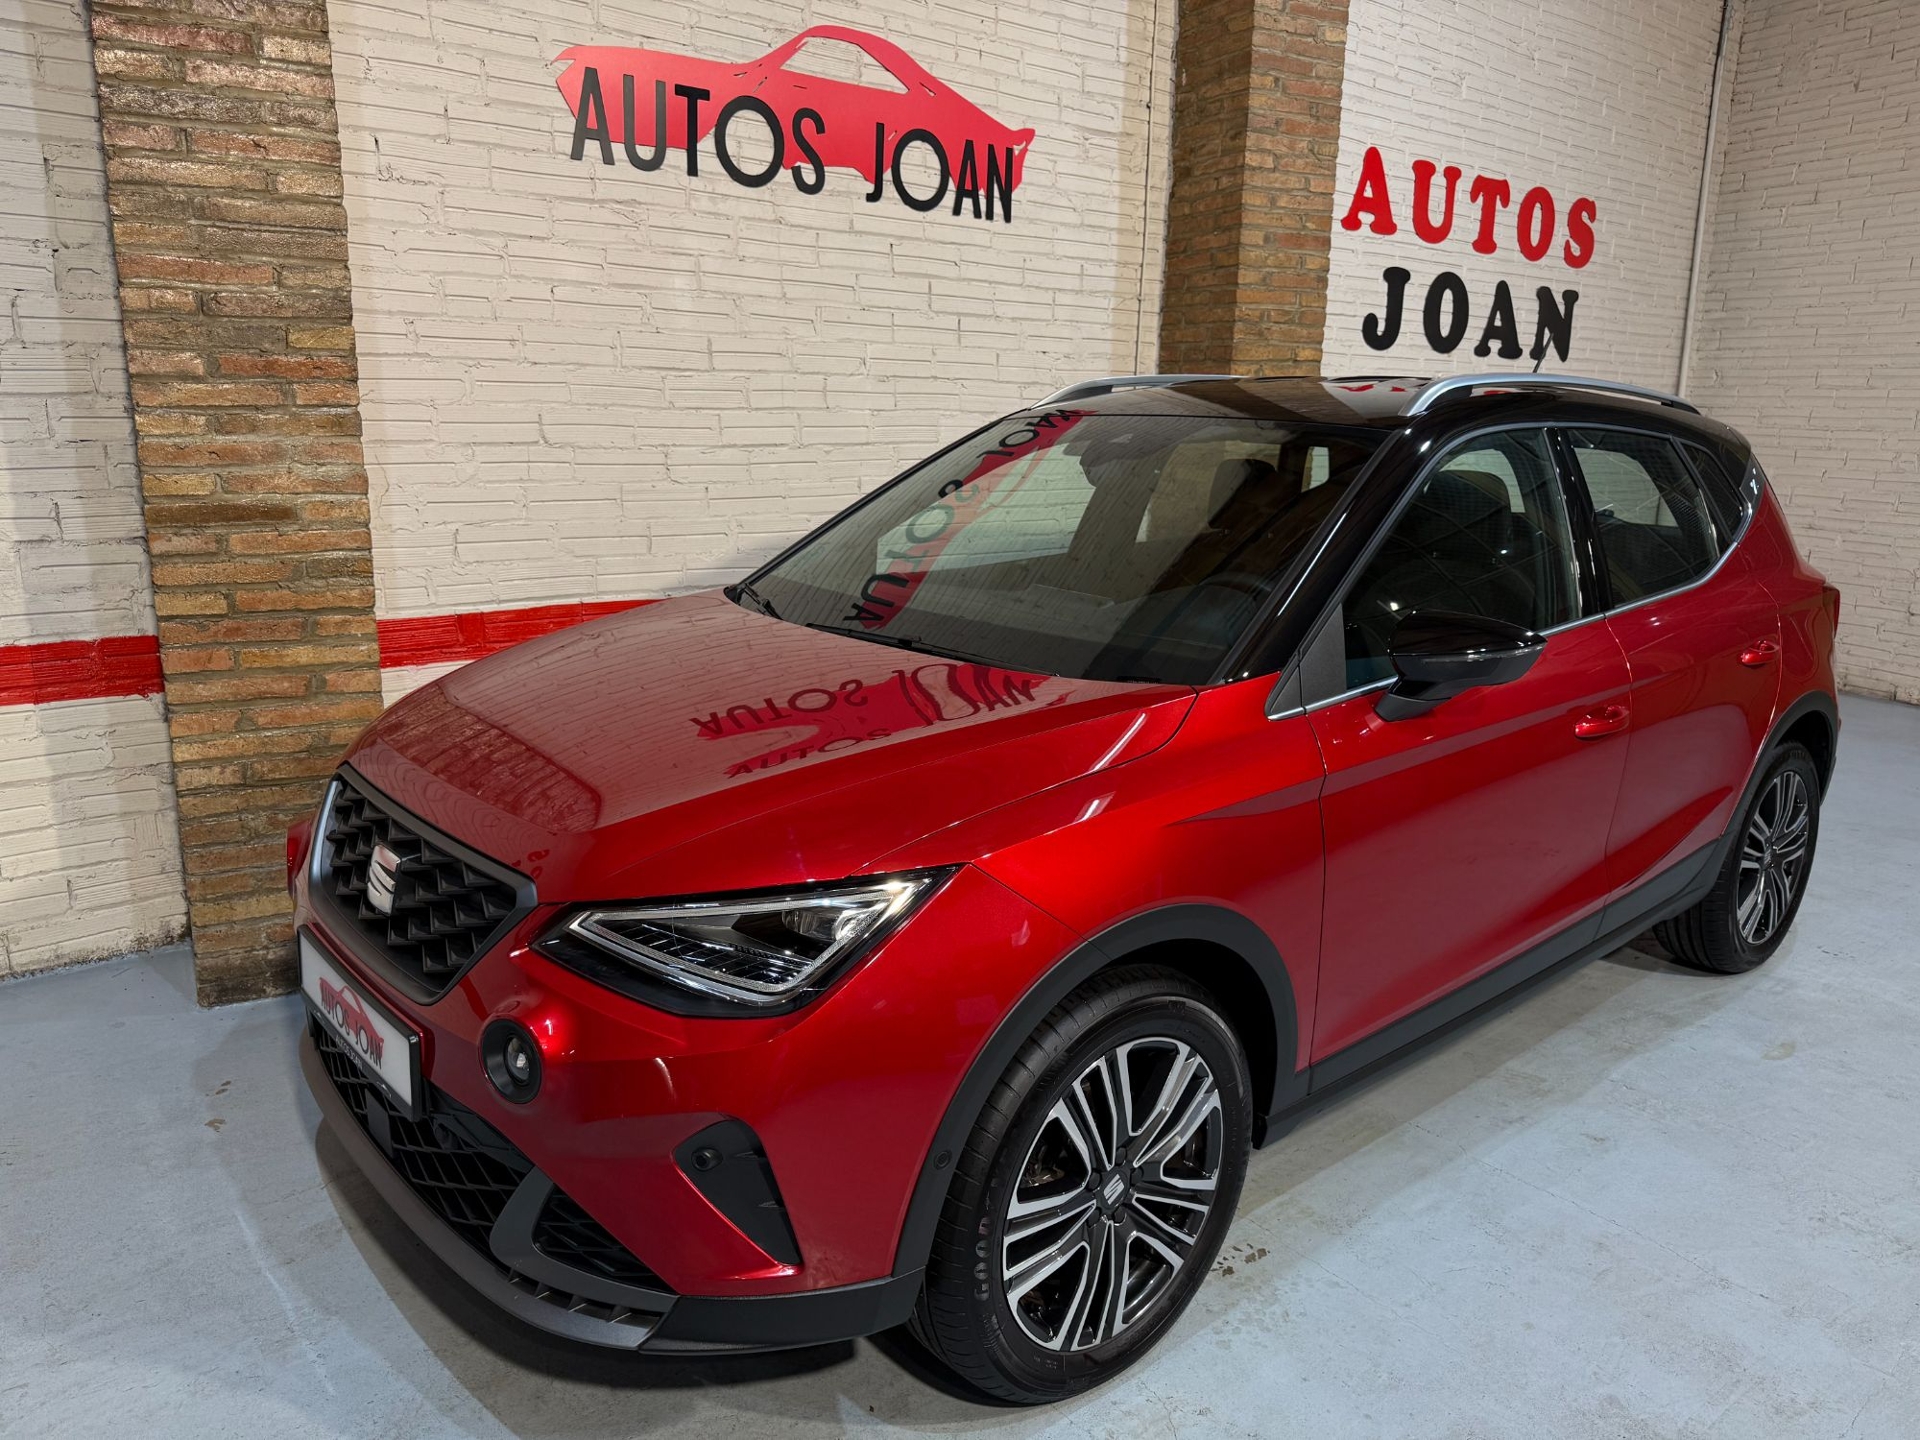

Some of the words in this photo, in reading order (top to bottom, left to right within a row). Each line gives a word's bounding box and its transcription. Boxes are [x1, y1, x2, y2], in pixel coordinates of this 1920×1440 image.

[570, 66, 826, 195] AUTOS
[865, 122, 1013, 223] JOAN
[1340, 146, 1597, 269] AUTOS
[1362, 266, 1579, 362] JOAN
[320, 982, 351, 1037] AUTOS
[355, 1020, 384, 1070] JOAN
